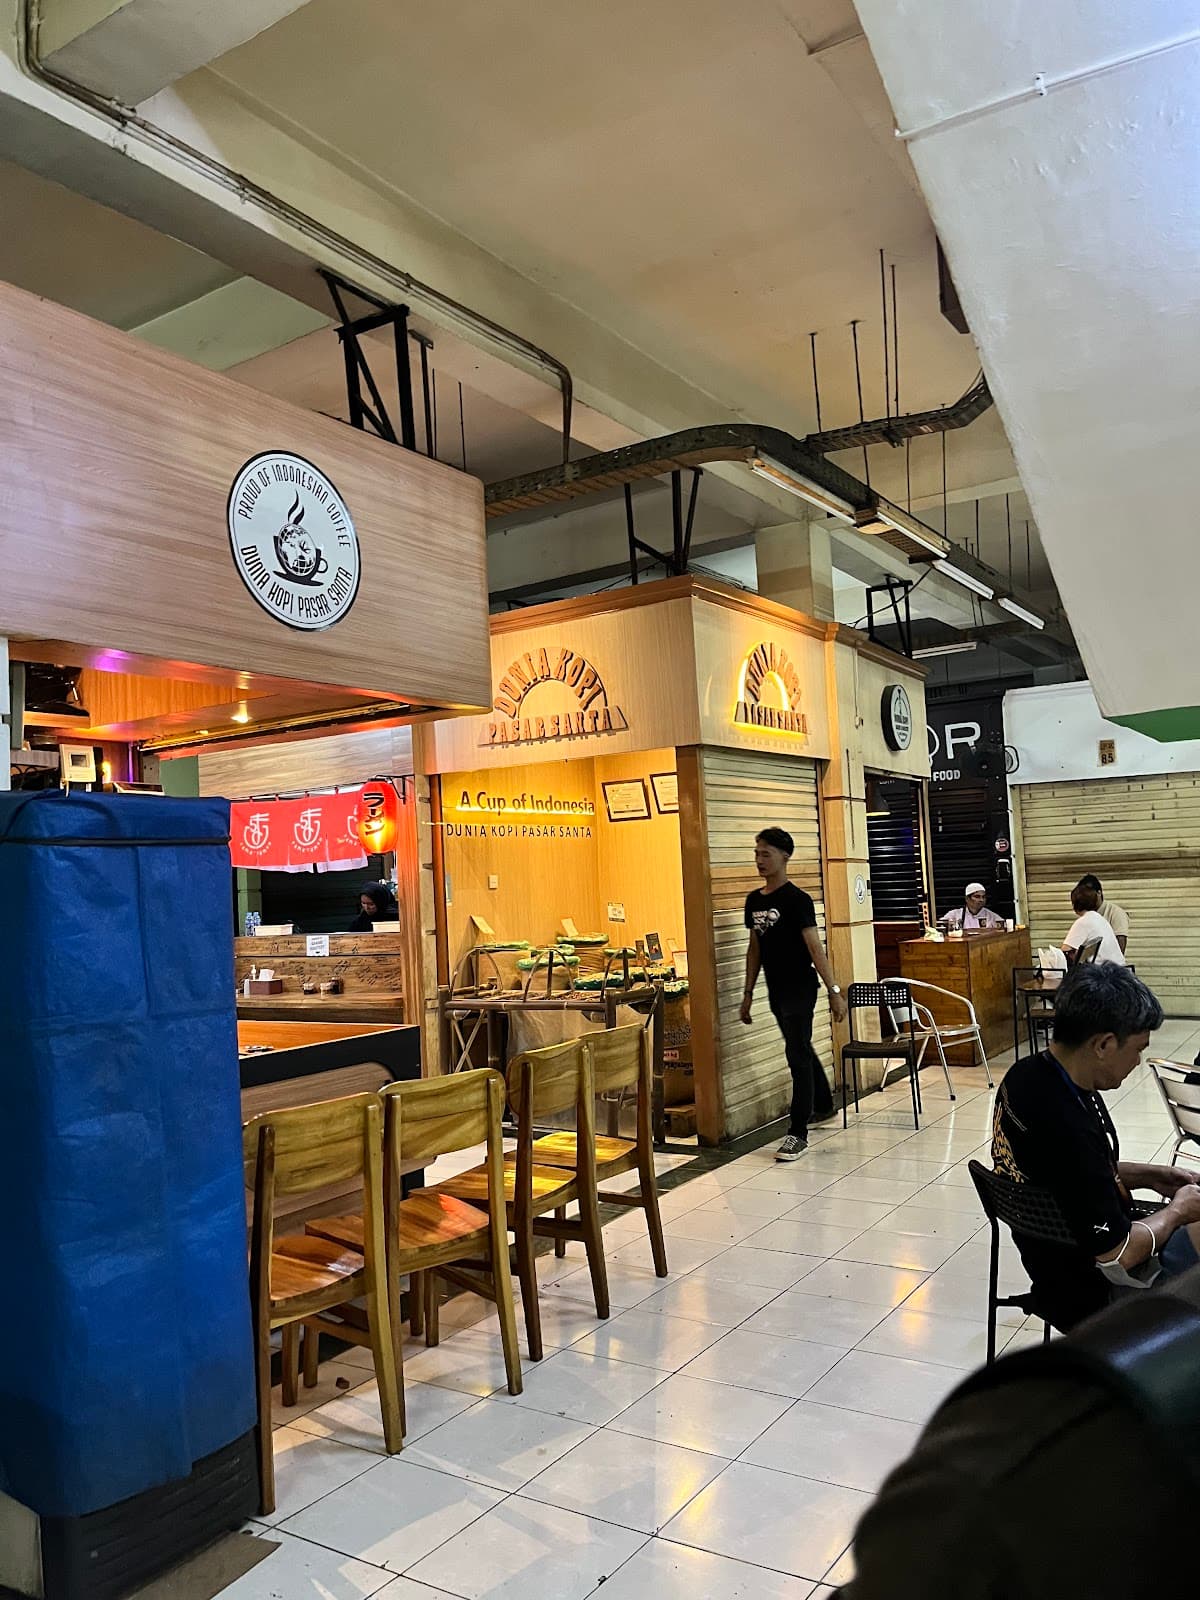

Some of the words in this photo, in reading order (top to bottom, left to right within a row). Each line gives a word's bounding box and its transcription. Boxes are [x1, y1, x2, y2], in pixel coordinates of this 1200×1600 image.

[238, 478, 262, 520] PROUD
[257, 467, 271, 487] OF
[271, 463, 329, 505] INDONESIAN
[326, 502, 351, 548] COFFEE
[240, 544, 271, 590] DUNIA
[267, 581, 294, 614] KOPI
[298, 594, 332, 619] PASAR
[327, 566, 353, 606] SANTA
[494, 648, 551, 719] DUNIA
[553, 648, 604, 712] KOPI
[932, 769, 961, 782] FOOD
[460, 790, 472, 809] A
[476, 791, 507, 816] Cup
[512, 793, 527, 811] of
[530, 795, 595, 814] Indonesia
[446, 823, 487, 838] DUNIA
[491, 825, 518, 838] KOPI
[522, 825, 556, 838] PASAR
[559, 826, 592, 839] SANTA
